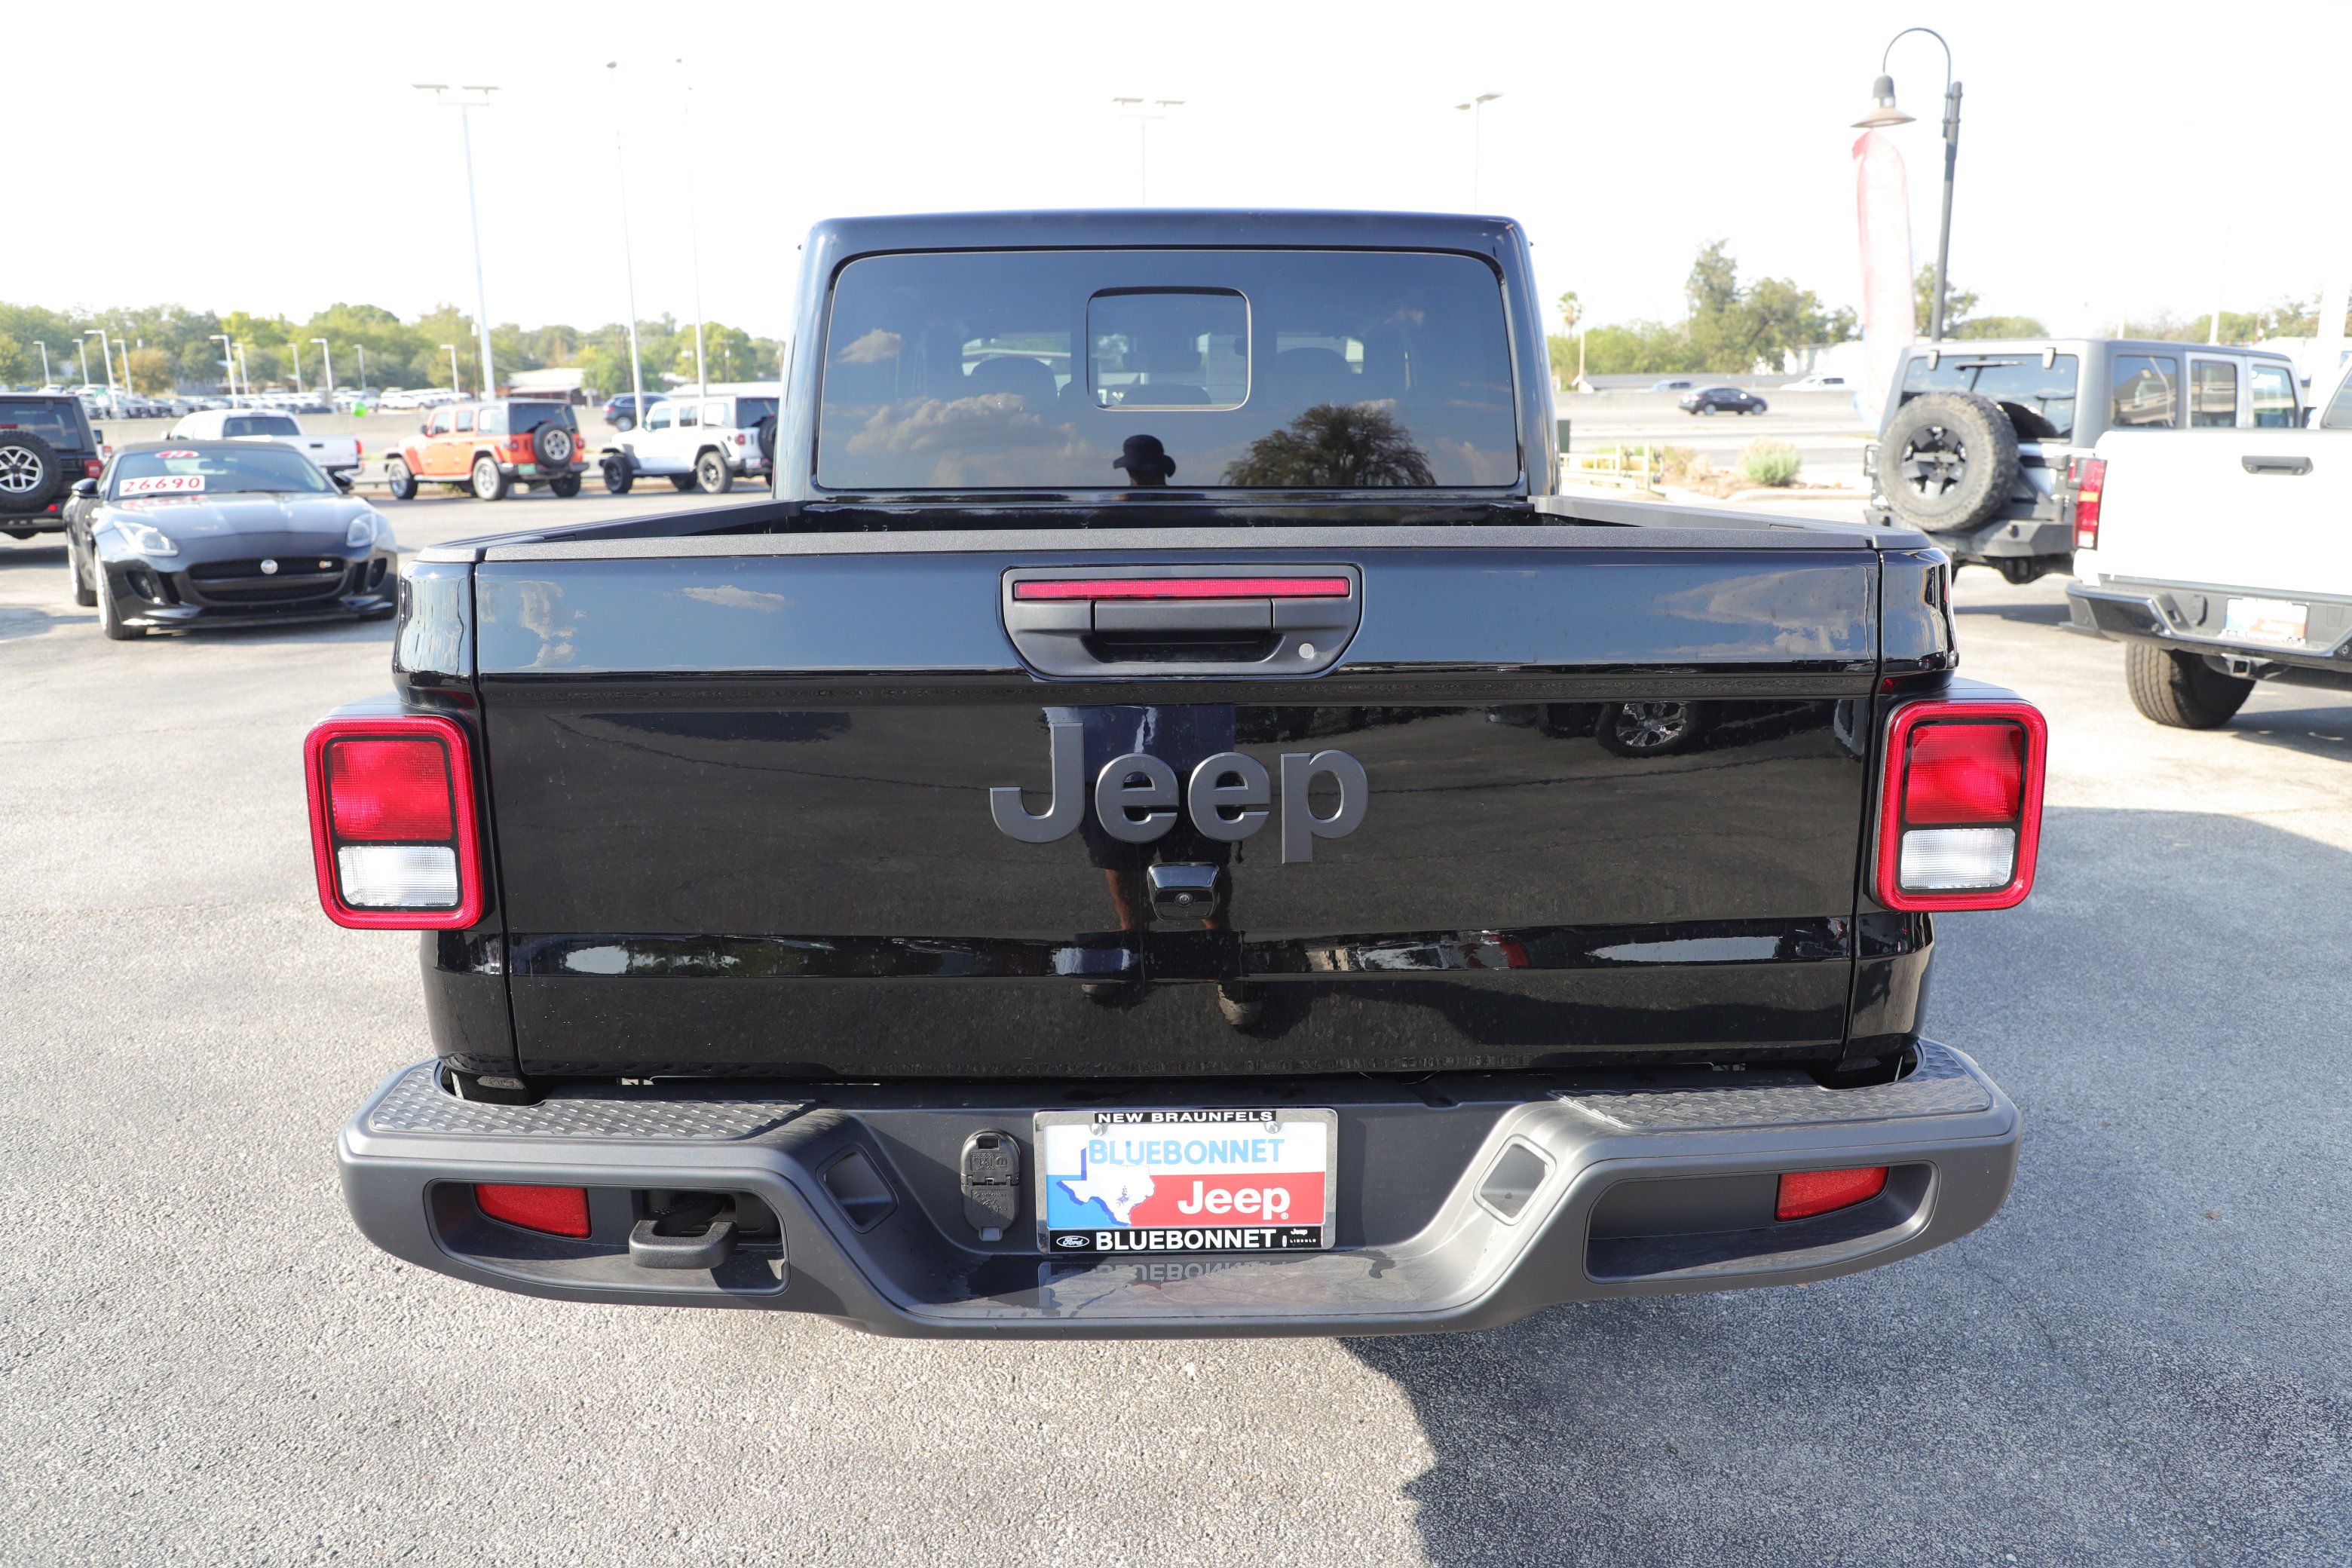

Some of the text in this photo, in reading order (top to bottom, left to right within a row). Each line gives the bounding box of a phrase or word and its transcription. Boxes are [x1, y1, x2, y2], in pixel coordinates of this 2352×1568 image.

[124, 477, 201, 492] 26690
[990, 721, 1369, 865] Jeep
[1098, 1111, 1273, 1123] NEW BRAUNFELS
[1089, 1139, 1285, 1165] BLUEBONNET
[1178, 1181, 1291, 1220] Jeep
[1096, 1230, 1276, 1251] BLUEBONNET
